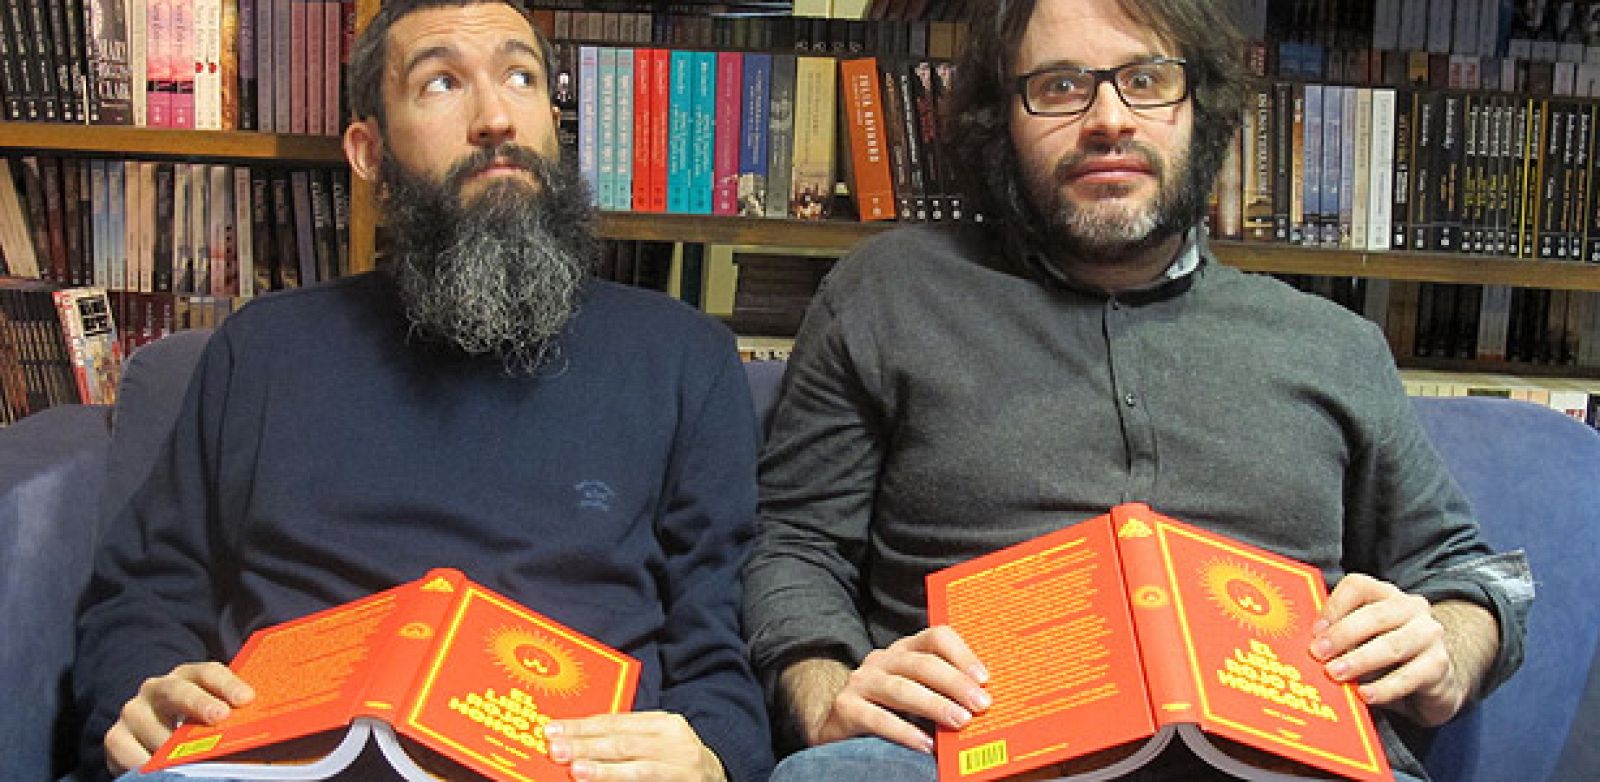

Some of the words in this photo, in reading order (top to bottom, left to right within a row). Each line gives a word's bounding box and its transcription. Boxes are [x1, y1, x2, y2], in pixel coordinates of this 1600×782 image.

[1234, 648, 1301, 682] LIBRO
[1250, 638, 1278, 662] EL
[510, 687, 537, 712] EL
[1216, 669, 1338, 723] MONGOLIA
[1224, 658, 1286, 689] ROJO
[1289, 681, 1322, 703] DE
[447, 696, 548, 755] MONGOL
[465, 692, 530, 731] ROJO
